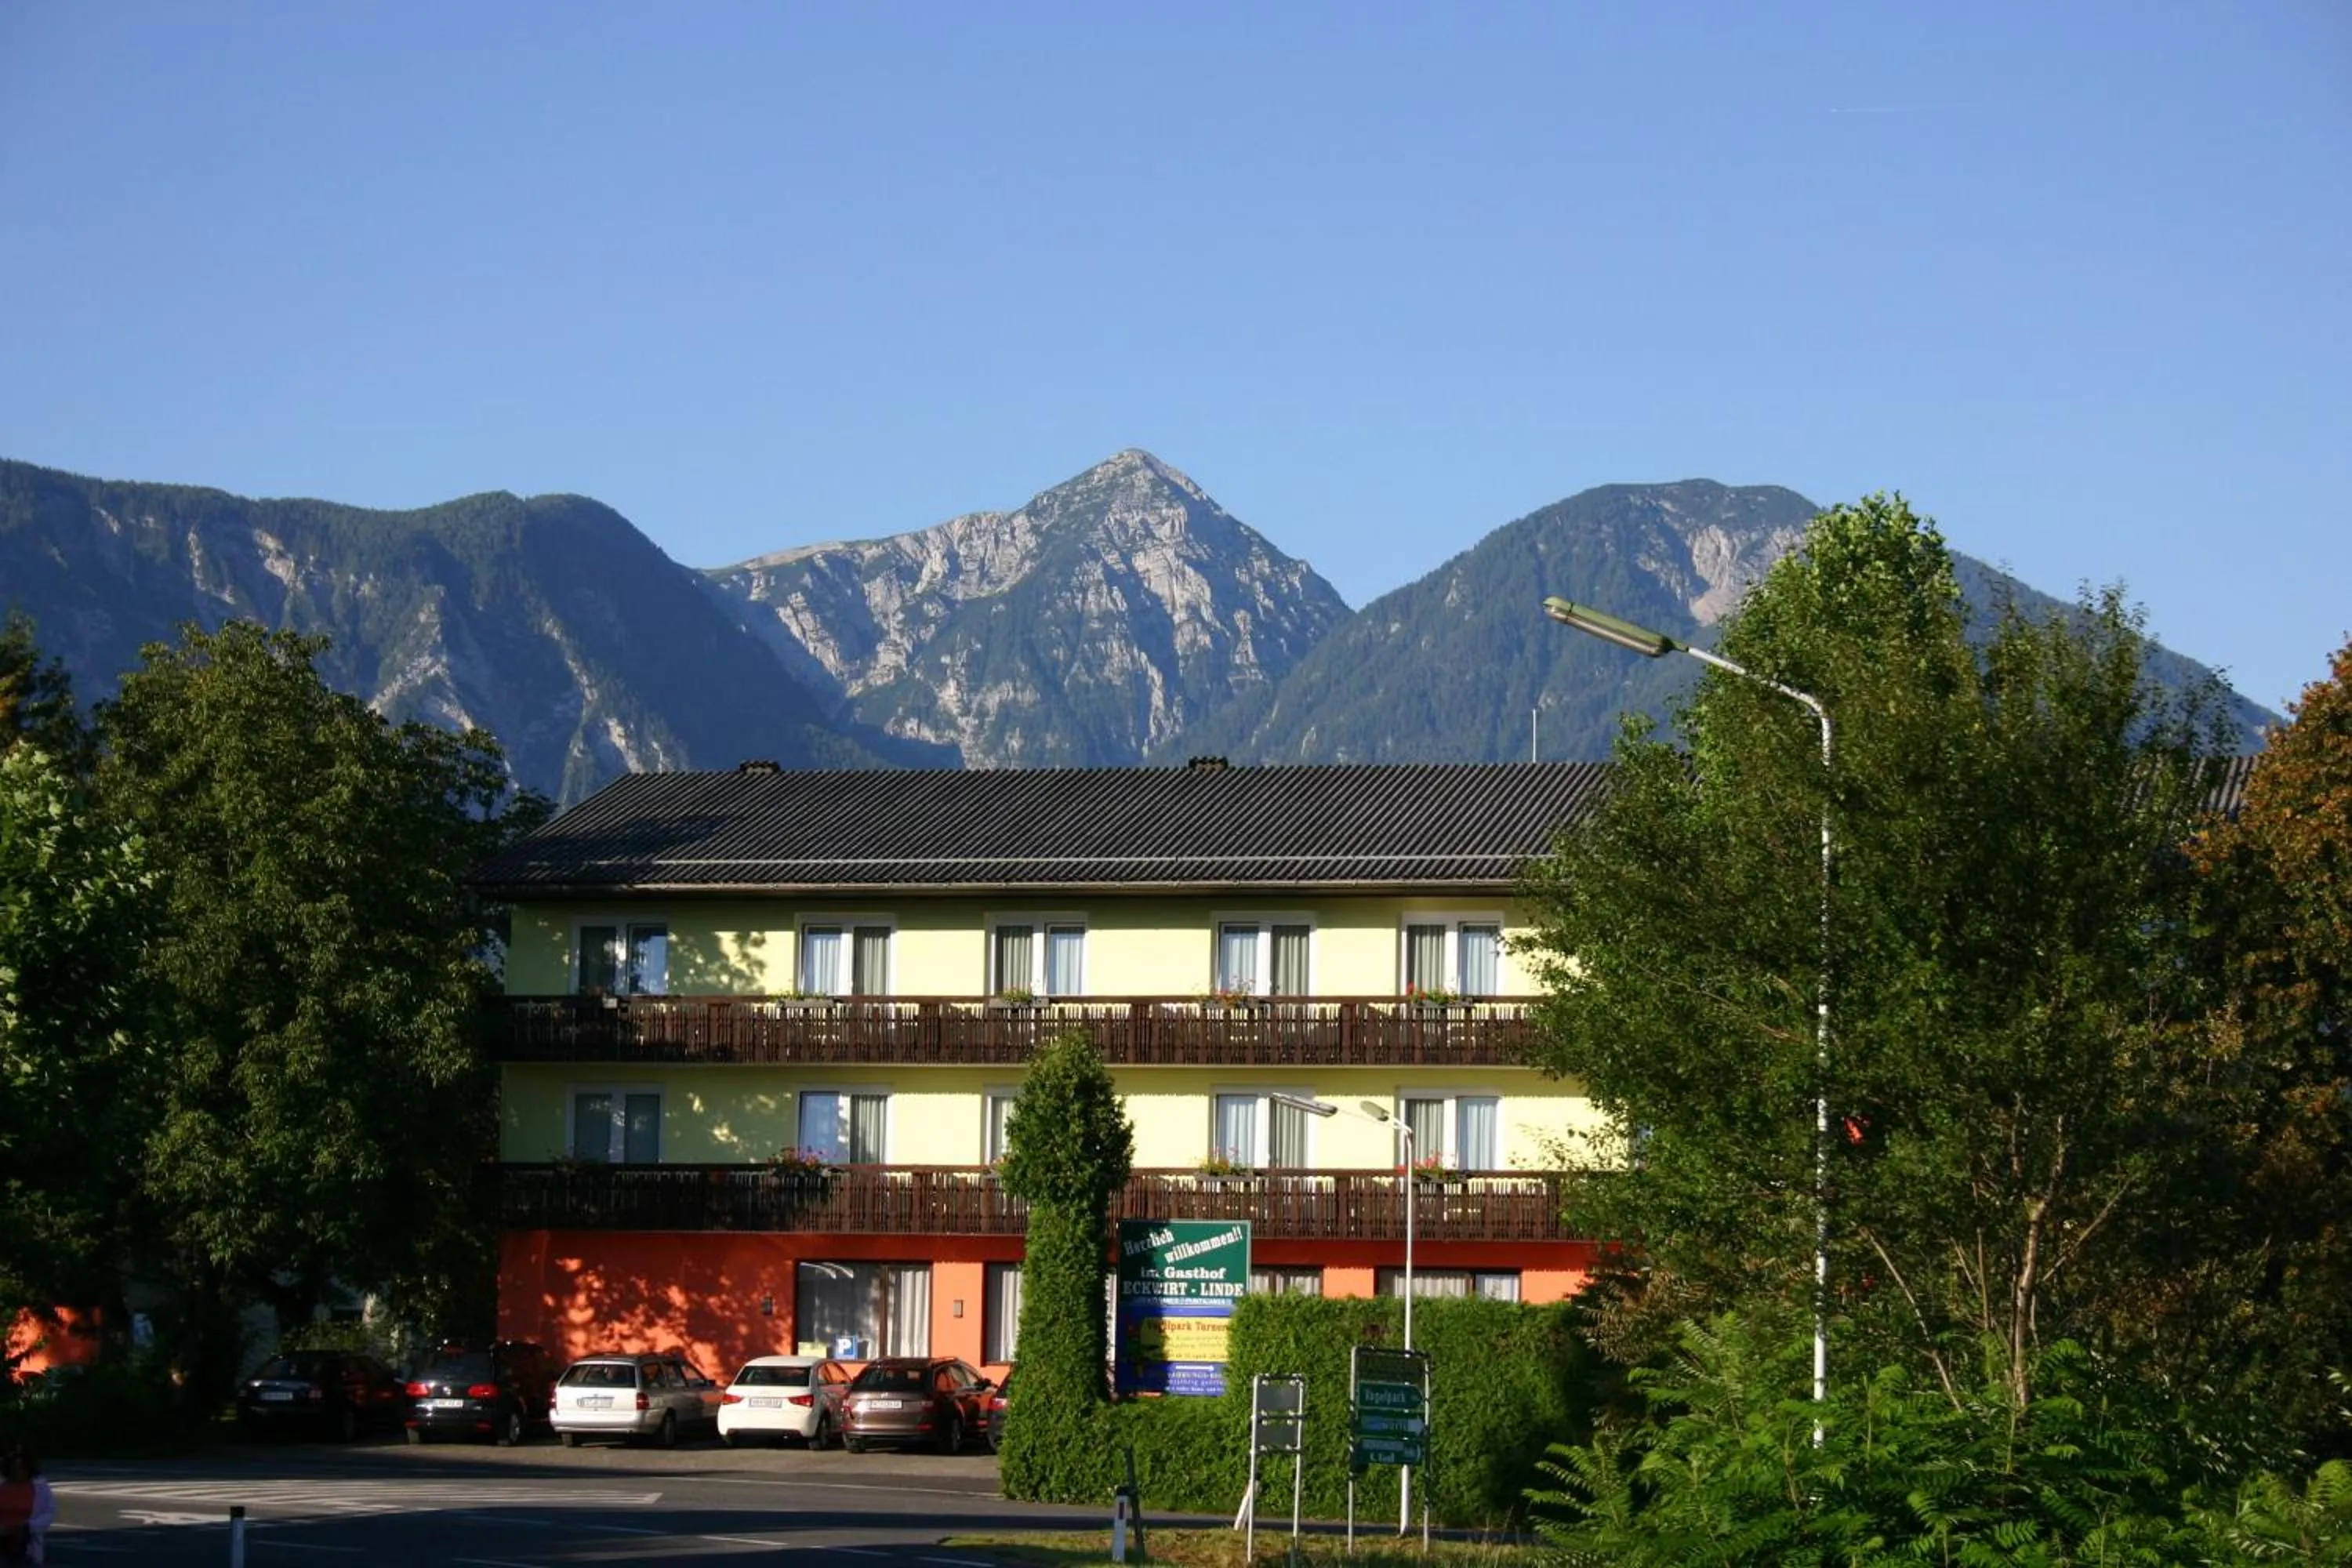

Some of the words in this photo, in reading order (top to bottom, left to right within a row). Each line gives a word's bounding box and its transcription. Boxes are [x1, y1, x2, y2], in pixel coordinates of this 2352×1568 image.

[1141, 1267, 1159, 1279] im
[1164, 1266, 1226, 1279] Gasthof
[1122, 1282, 1188, 1296] ECKWIRT
[1200, 1283, 1243, 1297] LINDE
[838, 1339, 851, 1354] P
